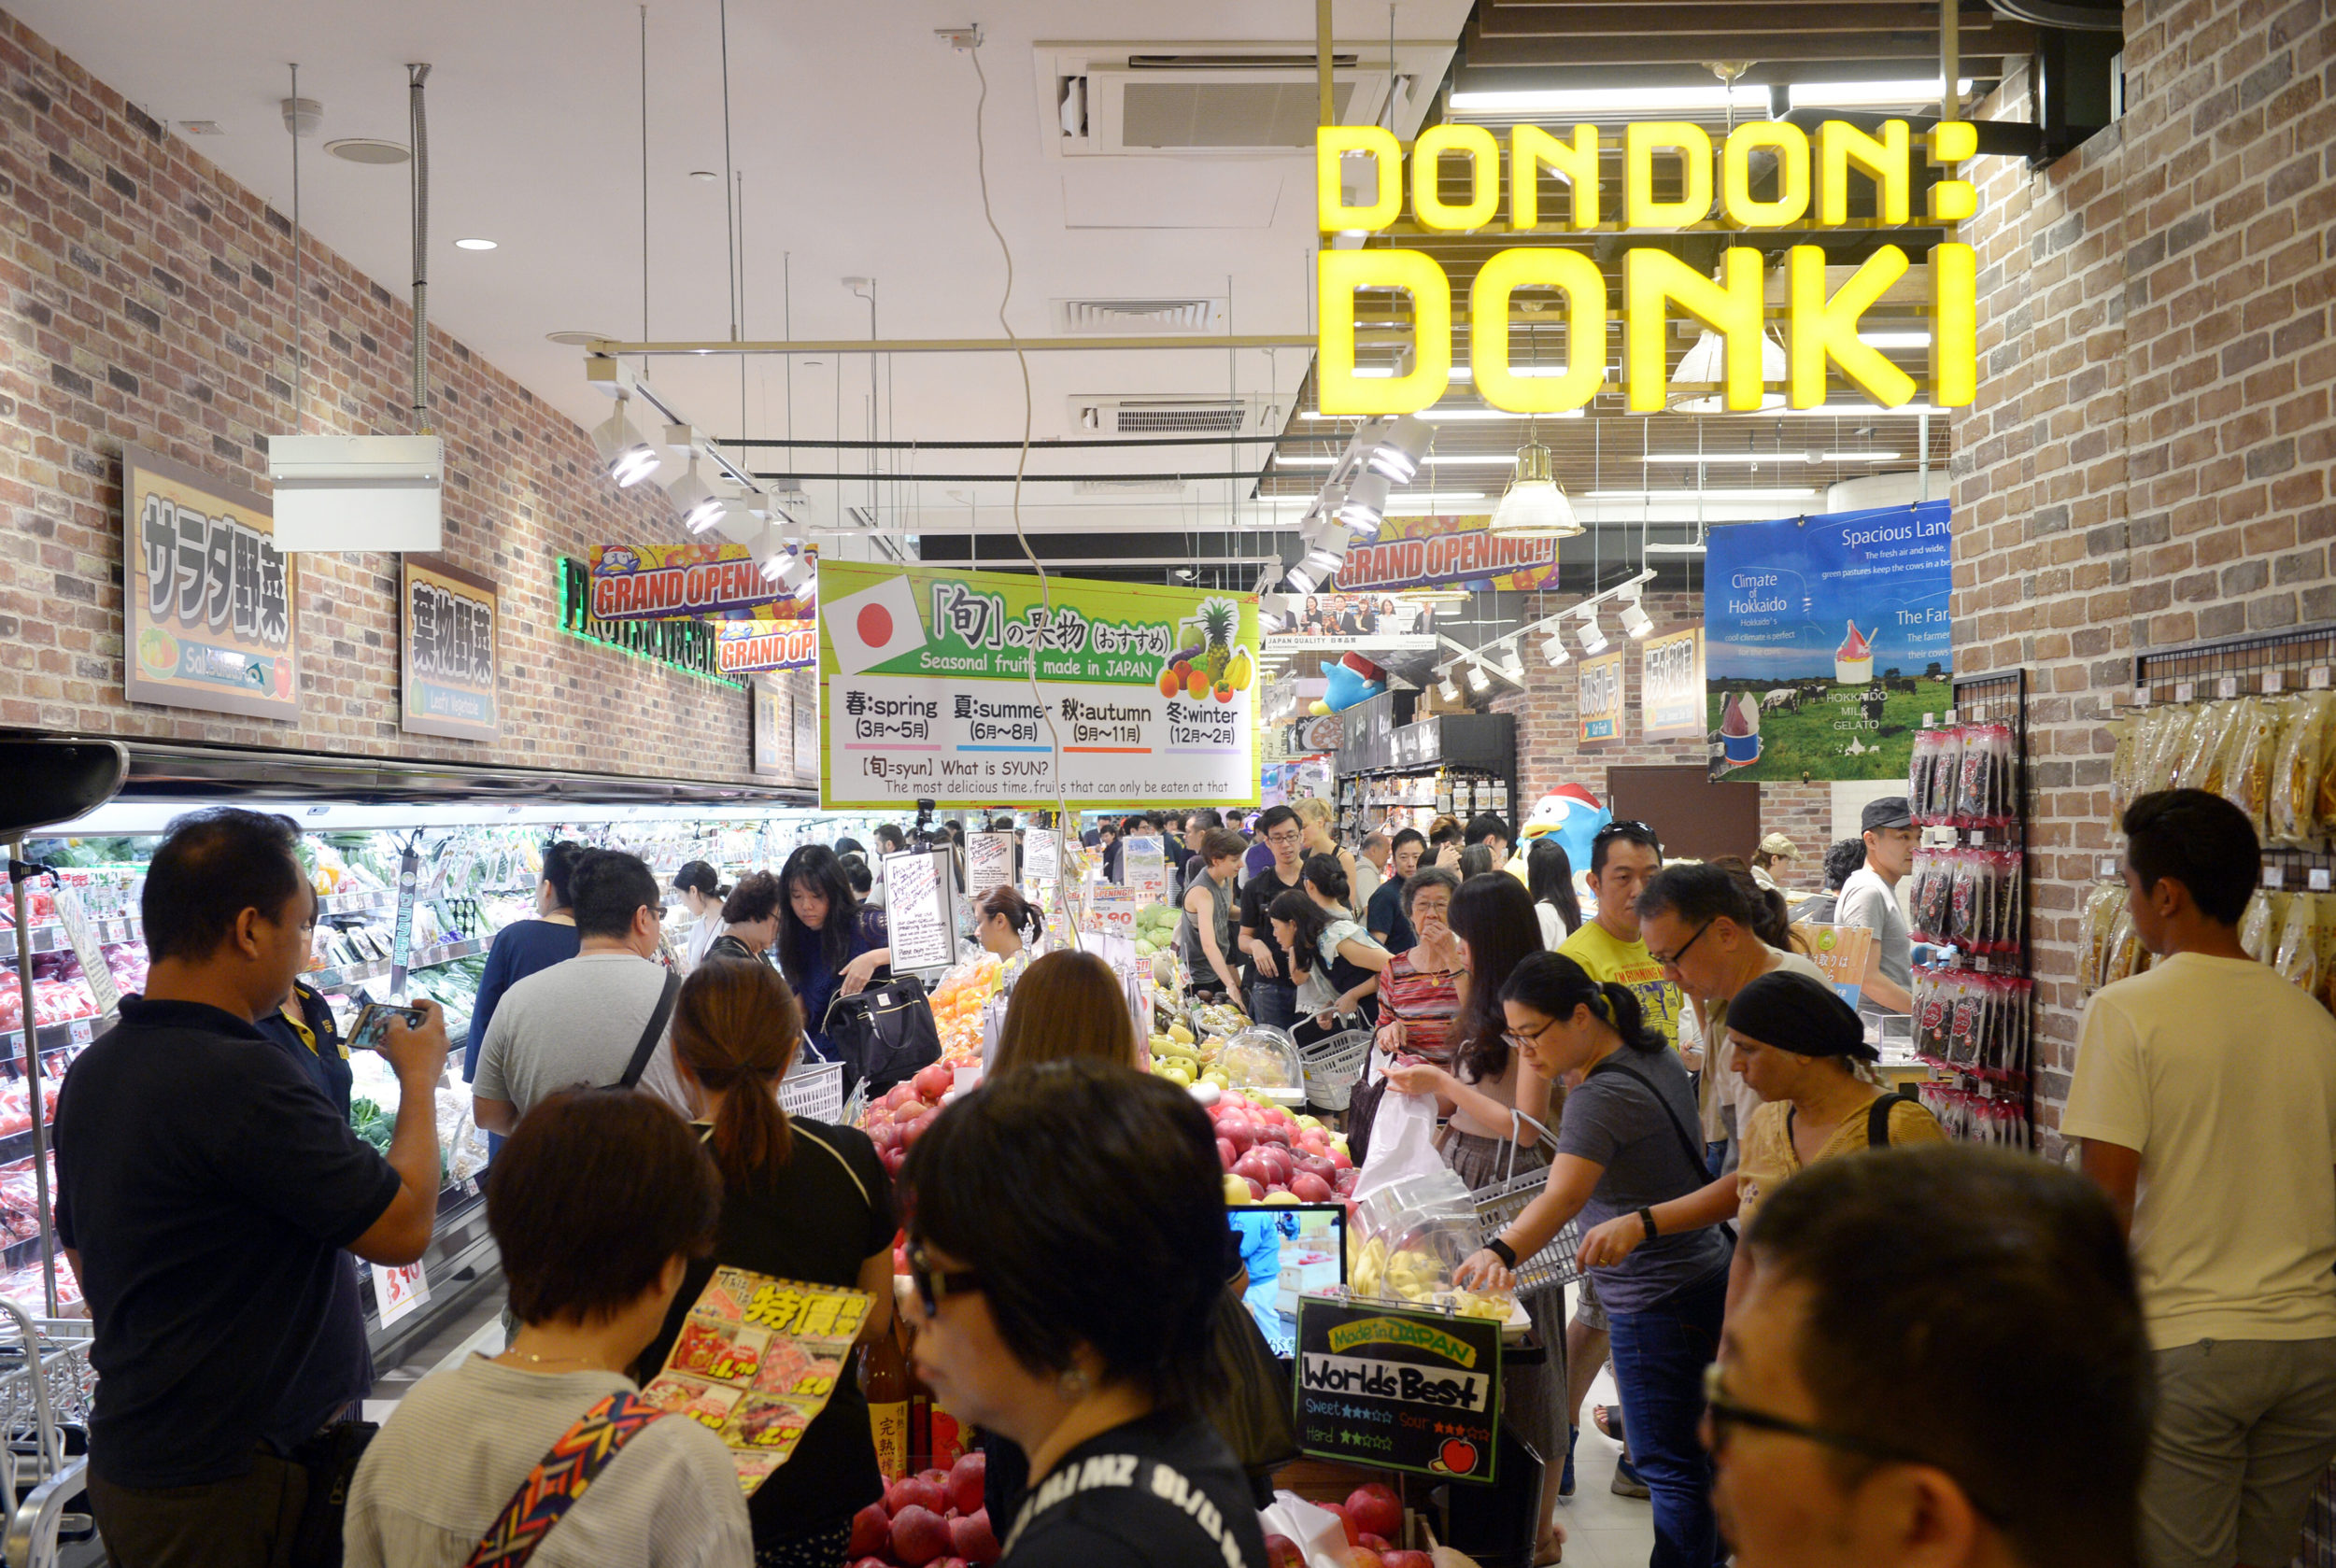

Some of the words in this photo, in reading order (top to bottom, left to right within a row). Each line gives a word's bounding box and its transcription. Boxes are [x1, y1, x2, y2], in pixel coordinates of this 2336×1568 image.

[1317, 243, 1976, 417] DONKI
[1842, 525, 1913, 549] Spacious
[1865, 551, 1878, 560] The
[1879, 549, 1898, 558] fresh
[1899, 548, 1908, 557] air
[1909, 546, 1924, 556] and
[1925, 544, 1947, 555] wide,
[143, 496, 288, 643] サラダ野菜
[1337, 544, 1423, 587] GRAND
[1821, 570, 1842, 580] green
[1842, 568, 1872, 578] pastures
[1873, 565, 1891, 575] keep
[1891, 563, 1904, 572] the
[1925, 560, 1933, 569] in
[595, 572, 685, 615] GRAND
[687, 562, 792, 605] OPENIN
[1732, 573, 1778, 589] Climate
[1748, 587, 1758, 599] of
[1729, 596, 1788, 614] Hokkaido
[1895, 608, 1922, 625] The
[1926, 608, 1951, 623] Far
[412, 582, 492, 684] 葉物野菜
[1295, 636, 1325, 644] QUALITY
[1725, 633, 1739, 642] cool
[1772, 630, 1795, 642] perfect
[1907, 633, 1922, 642] The
[720, 637, 786, 670] GRAND
[788, 632, 815, 661] OP
[1908, 649, 1927, 659] their
[1928, 649, 1948, 657] cows
[920, 652, 988, 671] Seasonal
[1043, 657, 1081, 675] made
[1087, 659, 1100, 675] in
[1106, 660, 1153, 678] JAPAN
[1826, 691, 1889, 702] HOKKAIDO
[1841, 706, 1868, 716] MILK
[1833, 719, 1879, 730] GELATO
[941, 760, 979, 775] What
[985, 761, 996, 775] is
[1001, 761, 1049, 776] SYUN?
[885, 779, 909, 793] The
[913, 782, 942, 793] most
[947, 780, 998, 793] delicious
[1034, 781, 1067, 793] fruis
[1070, 781, 1094, 793] that
[1097, 783, 1116, 793] can
[1120, 780, 1140, 796] only
[1144, 780, 1157, 793] be
[1161, 782, 1190, 793] eaten
[1193, 782, 1204, 793] at
[1207, 781, 1228, 793] that
[1334, 1324, 1370, 1349] Made
[1372, 1322, 1389, 1339] in
[1385, 1318, 1470, 1363] JAPAN
[1304, 1356, 1398, 1399] World's
[1398, 1366, 1479, 1410] Best
[1306, 1398, 1343, 1417] Sweet
[1400, 1411, 1431, 1430] Sour
[1306, 1426, 1335, 1444] Hard
